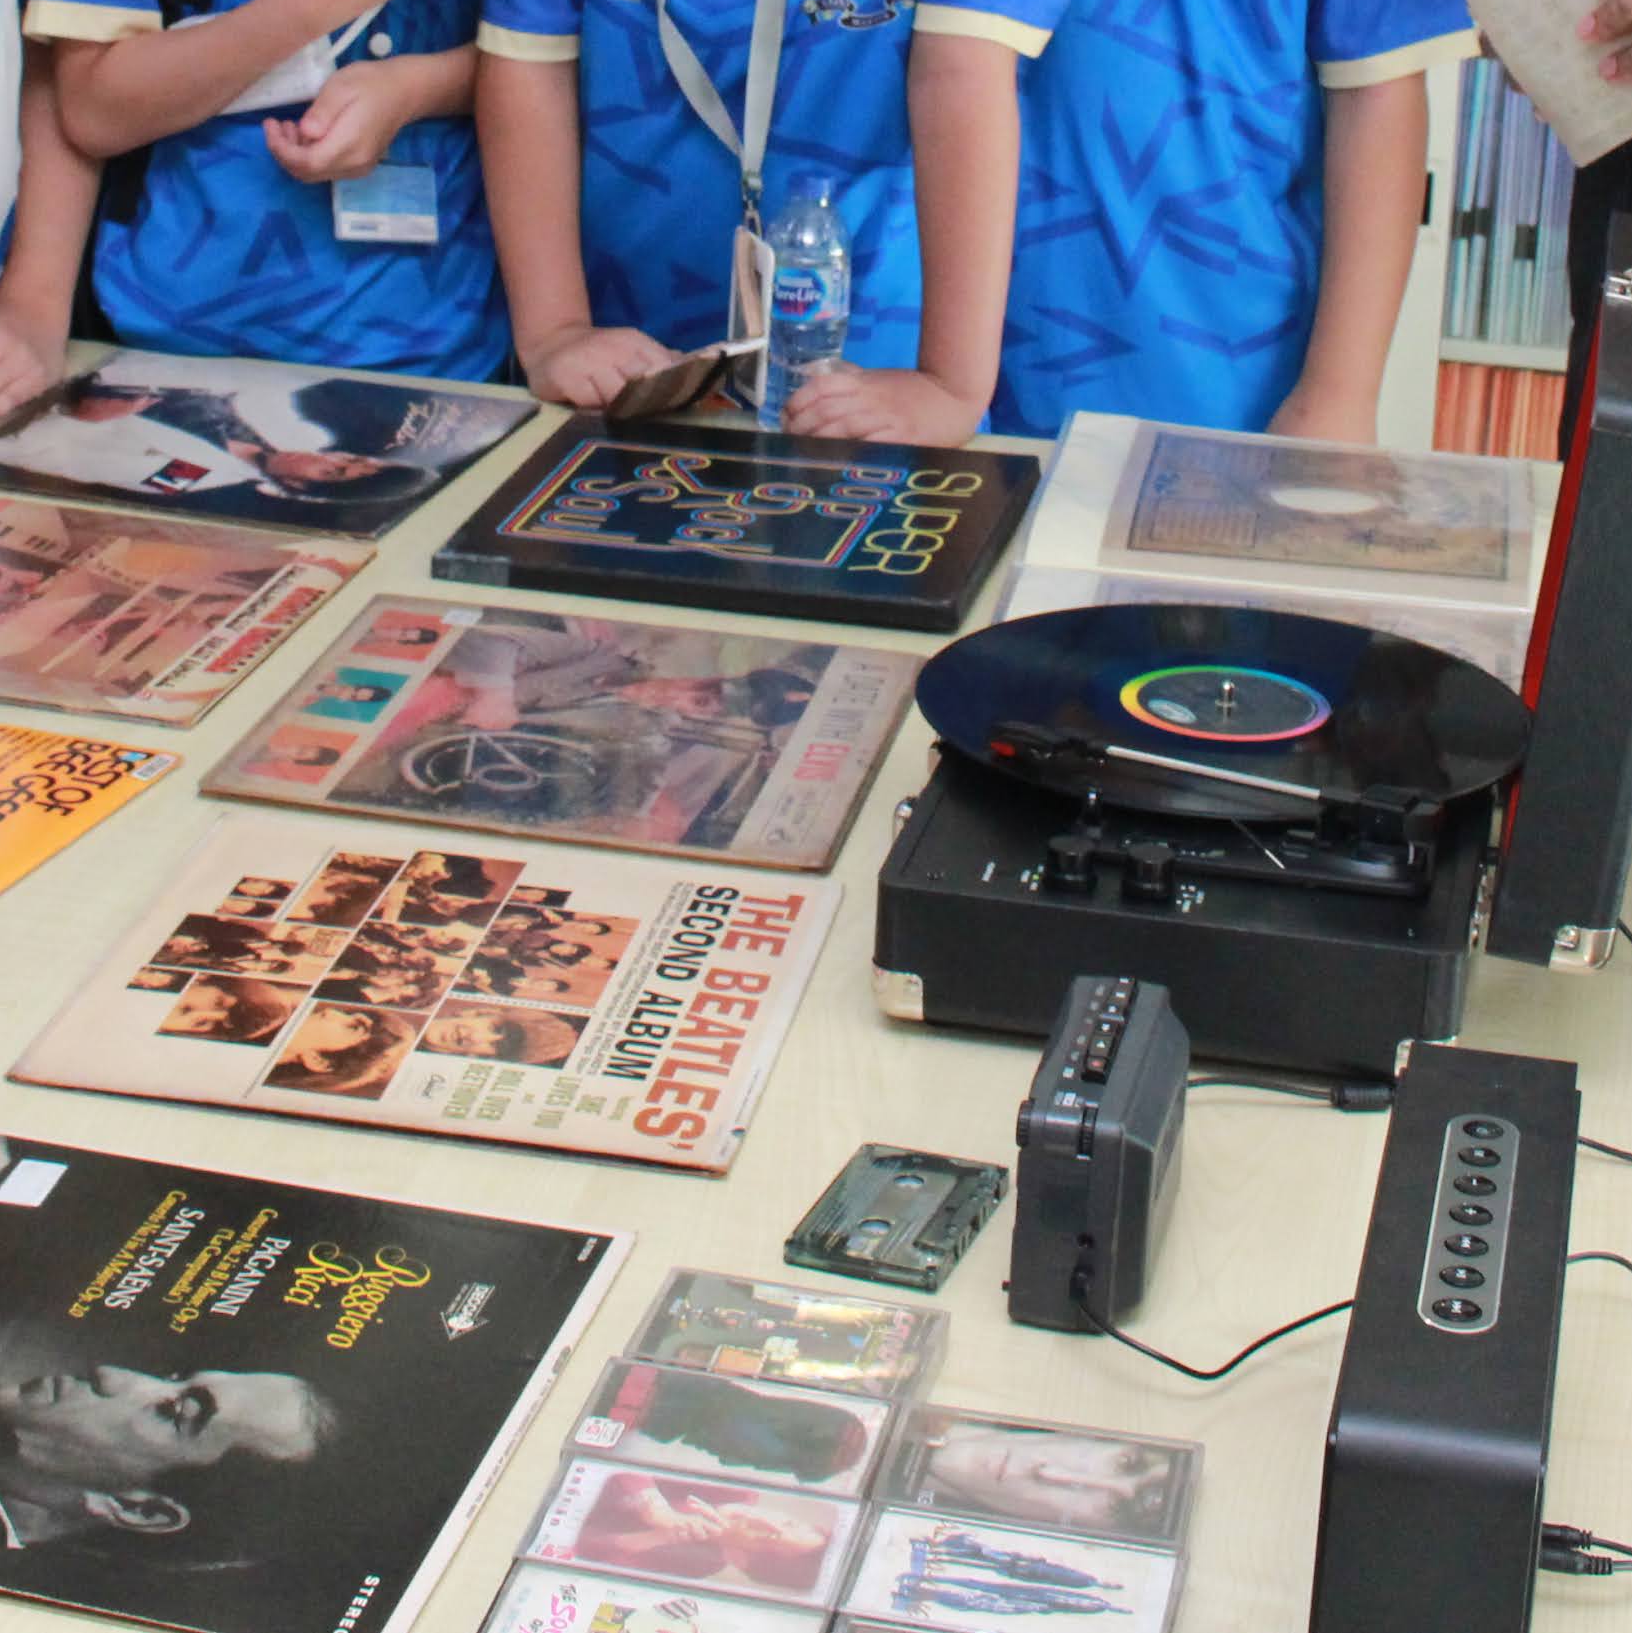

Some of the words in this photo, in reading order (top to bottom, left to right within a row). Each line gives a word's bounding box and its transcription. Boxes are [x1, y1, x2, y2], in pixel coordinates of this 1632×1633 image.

[25, 784, 100, 817] OF
[650, 884, 741, 984] SECOND
[715, 889, 806, 957] THE
[598, 990, 688, 1082] ALBUM
[623, 966, 773, 1151] BEATLES'
[207, 1236, 292, 1316] PAGANINI
[283, 1239, 377, 1311] Ricci
[326, 1243, 433, 1350] Ruggiero
[455, 1283, 492, 1318] DECCA
